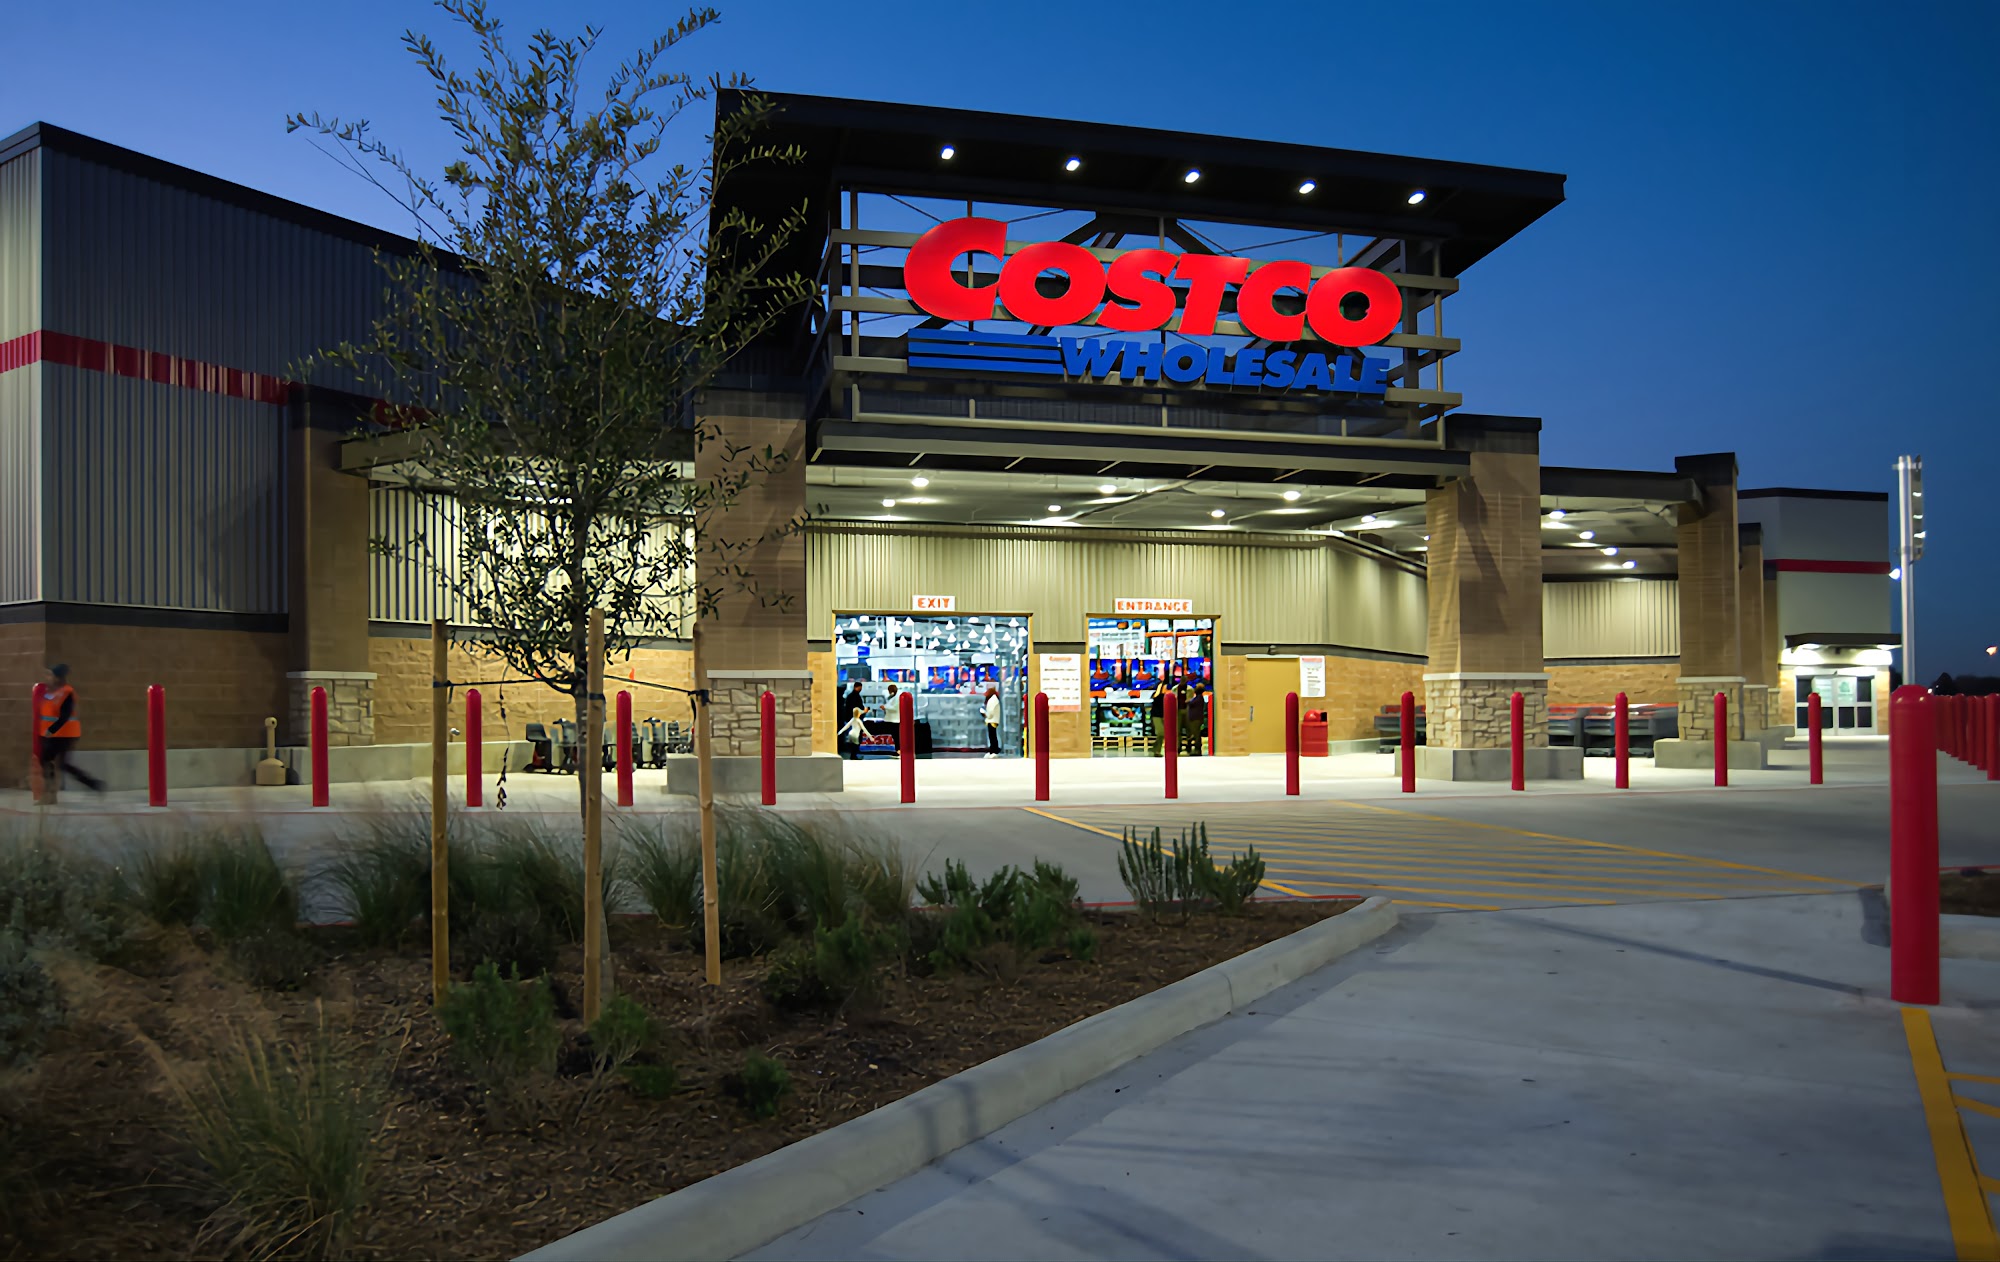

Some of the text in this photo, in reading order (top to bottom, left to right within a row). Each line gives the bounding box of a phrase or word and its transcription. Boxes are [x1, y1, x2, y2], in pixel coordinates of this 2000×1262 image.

[903, 217, 1402, 347] COSTCO
[1060, 336, 1391, 394] WHOLESALE
[917, 597, 951, 609] EXIT
[1117, 600, 1190, 613] ENTRANCE
